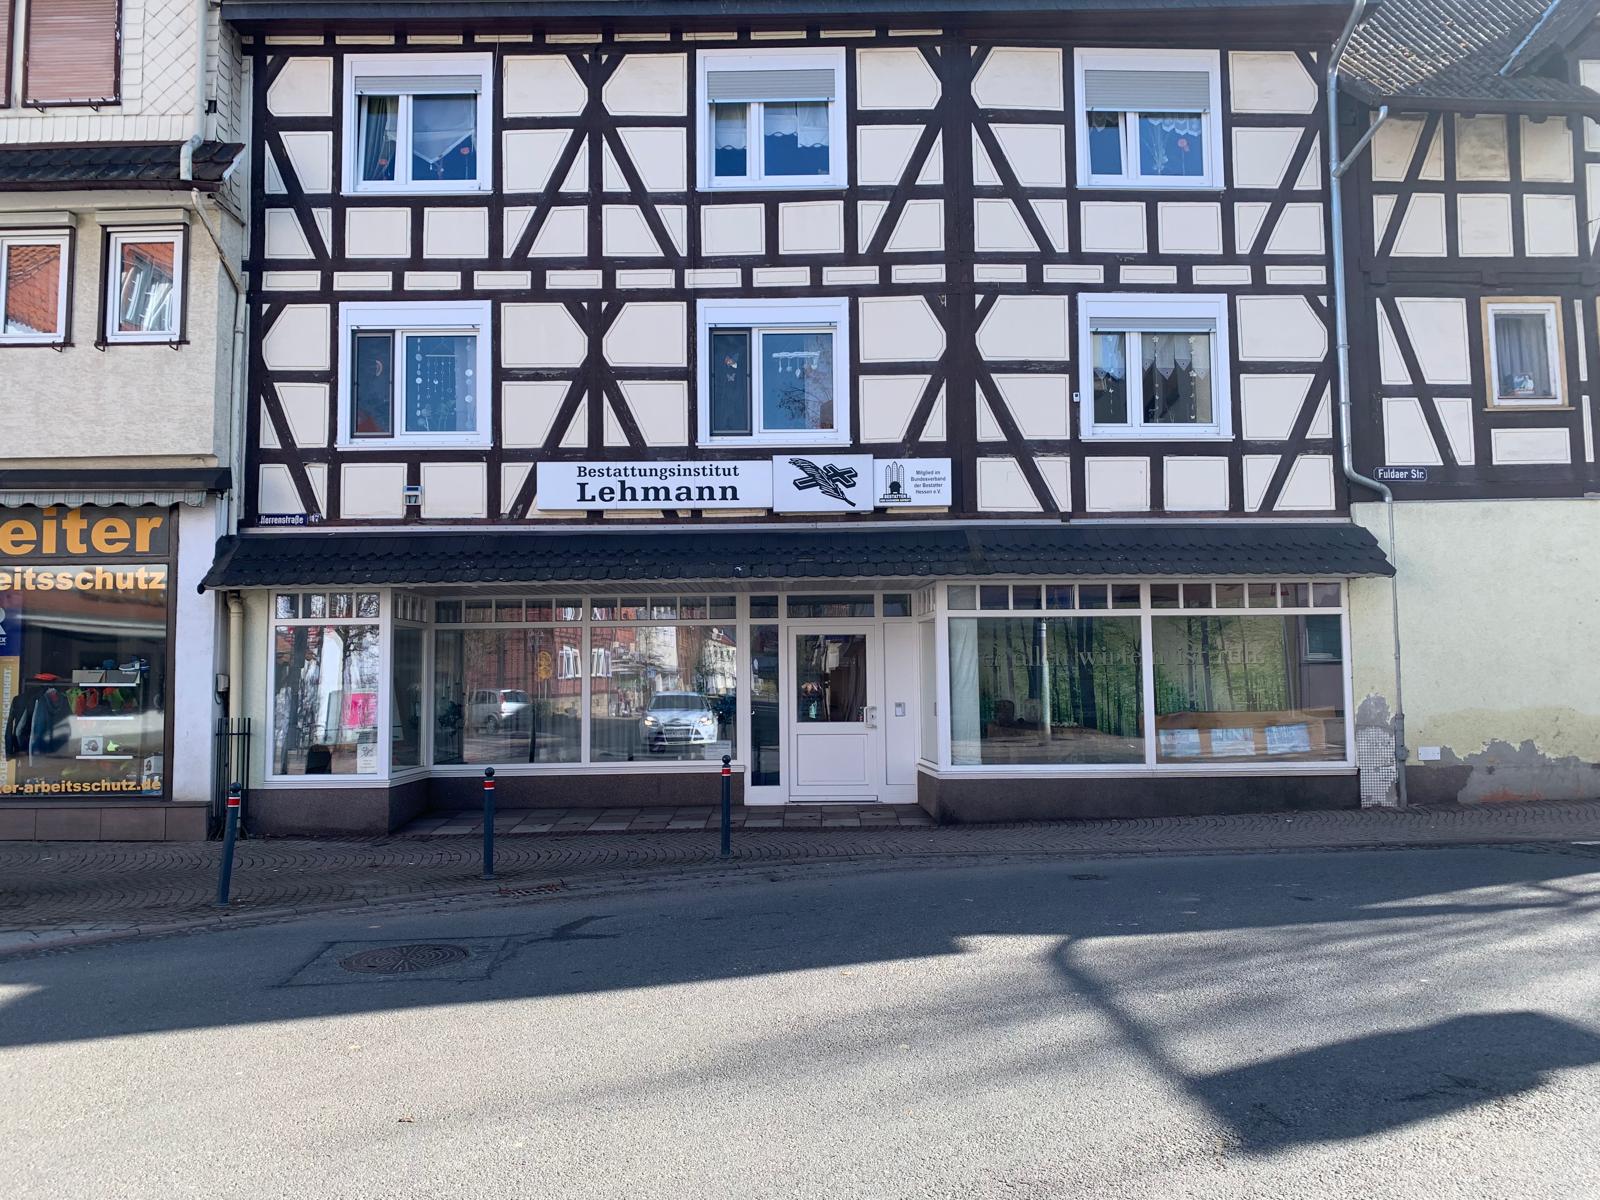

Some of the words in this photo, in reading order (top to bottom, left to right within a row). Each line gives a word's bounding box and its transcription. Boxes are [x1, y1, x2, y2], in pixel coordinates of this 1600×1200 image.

[577, 464, 739, 480] Bestattungsinstitut
[1378, 469, 1408, 478] Fuldaer
[1411, 468, 1424, 478] Str.
[577, 480, 740, 502] Lehmann
[261, 516, 303, 525] Herrenstraße
[0, 778, 161, 793] er-arbeitsschutz.de
